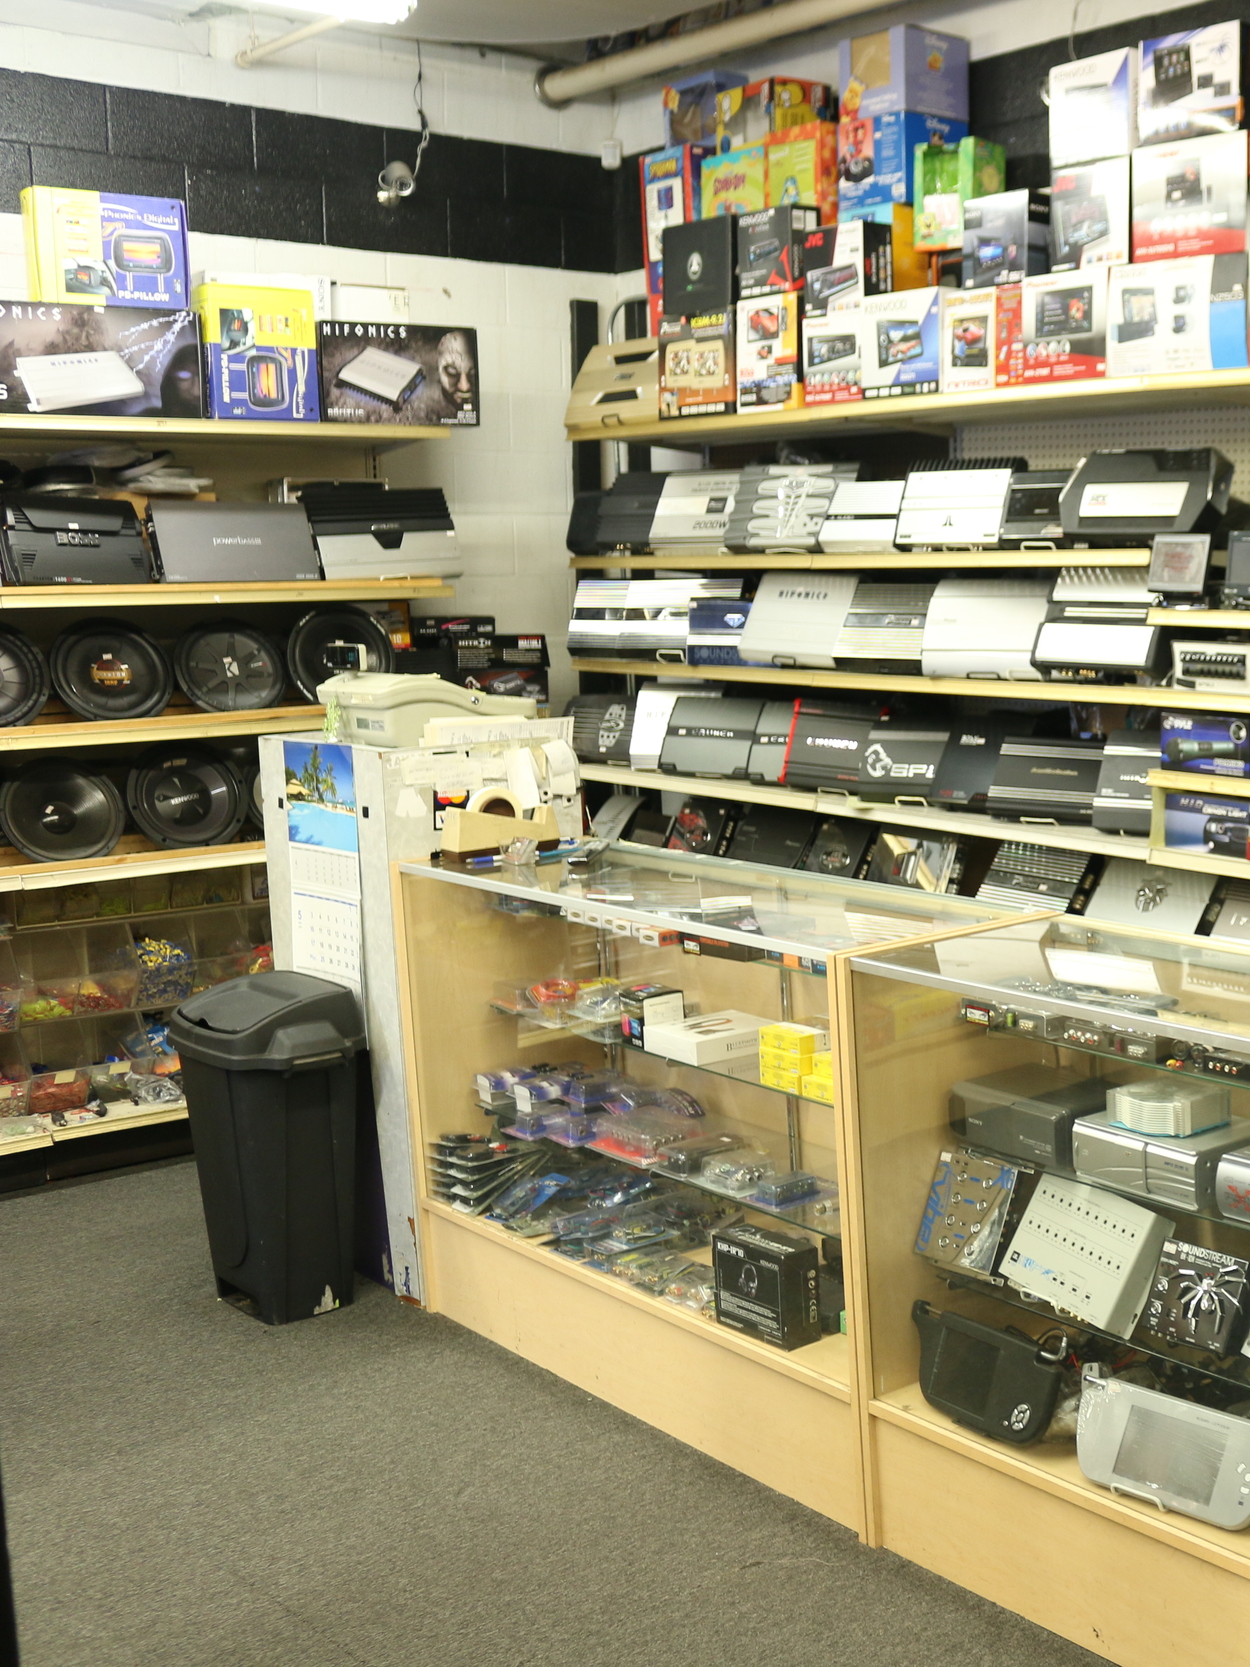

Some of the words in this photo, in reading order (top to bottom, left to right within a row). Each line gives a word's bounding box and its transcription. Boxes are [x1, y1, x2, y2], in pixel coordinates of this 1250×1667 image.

[739, 211, 770, 227] KENWOOD
[804, 232, 825, 249] JVC
[118, 289, 170, 302] PD-PILLOW
[317, 277, 326, 313] SONY
[0, 305, 62, 322] NICS
[864, 299, 907, 315] KENWOOD
[322, 322, 408, 340] HIFONICS
[778, 589, 829, 601] HIFONICS
[1173, 716, 1193, 731] PYLE
[169, 792, 200, 806] KENWOOD
[1180, 797, 1203, 809] HID
[1177, 1241, 1236, 1268] SOUNDSTREAM
